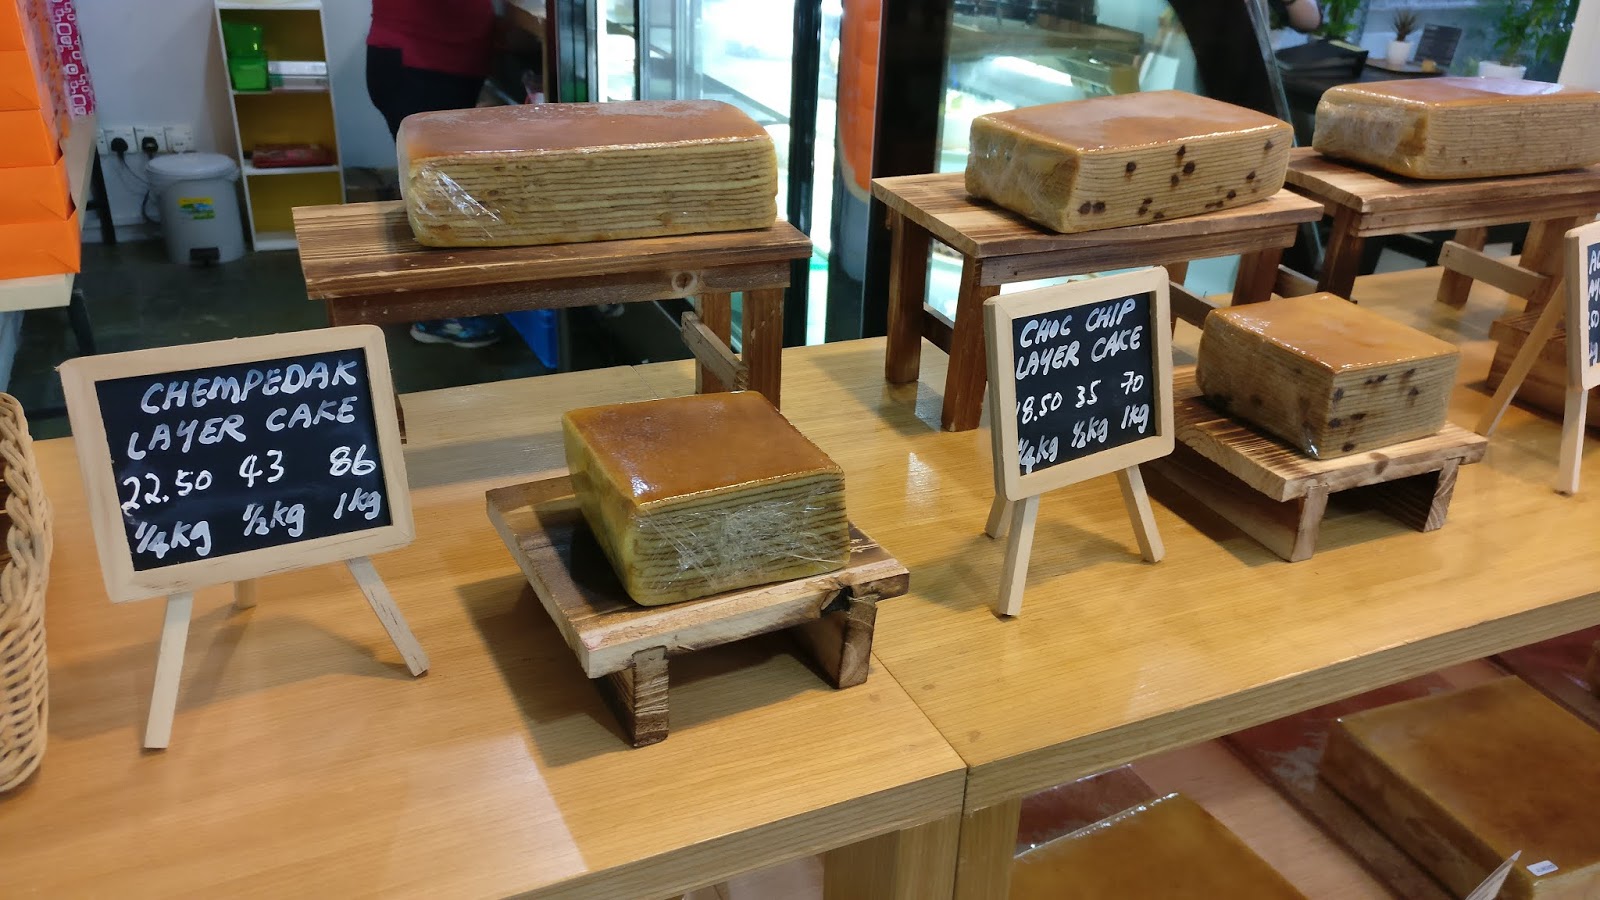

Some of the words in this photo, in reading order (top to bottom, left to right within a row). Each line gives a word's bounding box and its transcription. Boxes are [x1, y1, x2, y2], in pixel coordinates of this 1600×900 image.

[1019, 315, 1073, 348] CHOC
[1085, 298, 1136, 332] CHIP
[1015, 340, 1080, 380] LAYER
[1090, 325, 1143, 363] CAKE
[140, 359, 357, 415] CHEMPEDAK
[1075, 380, 1102, 408] 35
[1120, 370, 1144, 395] 70
[127, 413, 247, 461] LAYER
[265, 395, 358, 433] CAKE
[120, 468, 214, 516] 22.50
[238, 448, 285, 488] 43
[329, 443, 376, 477] 86
